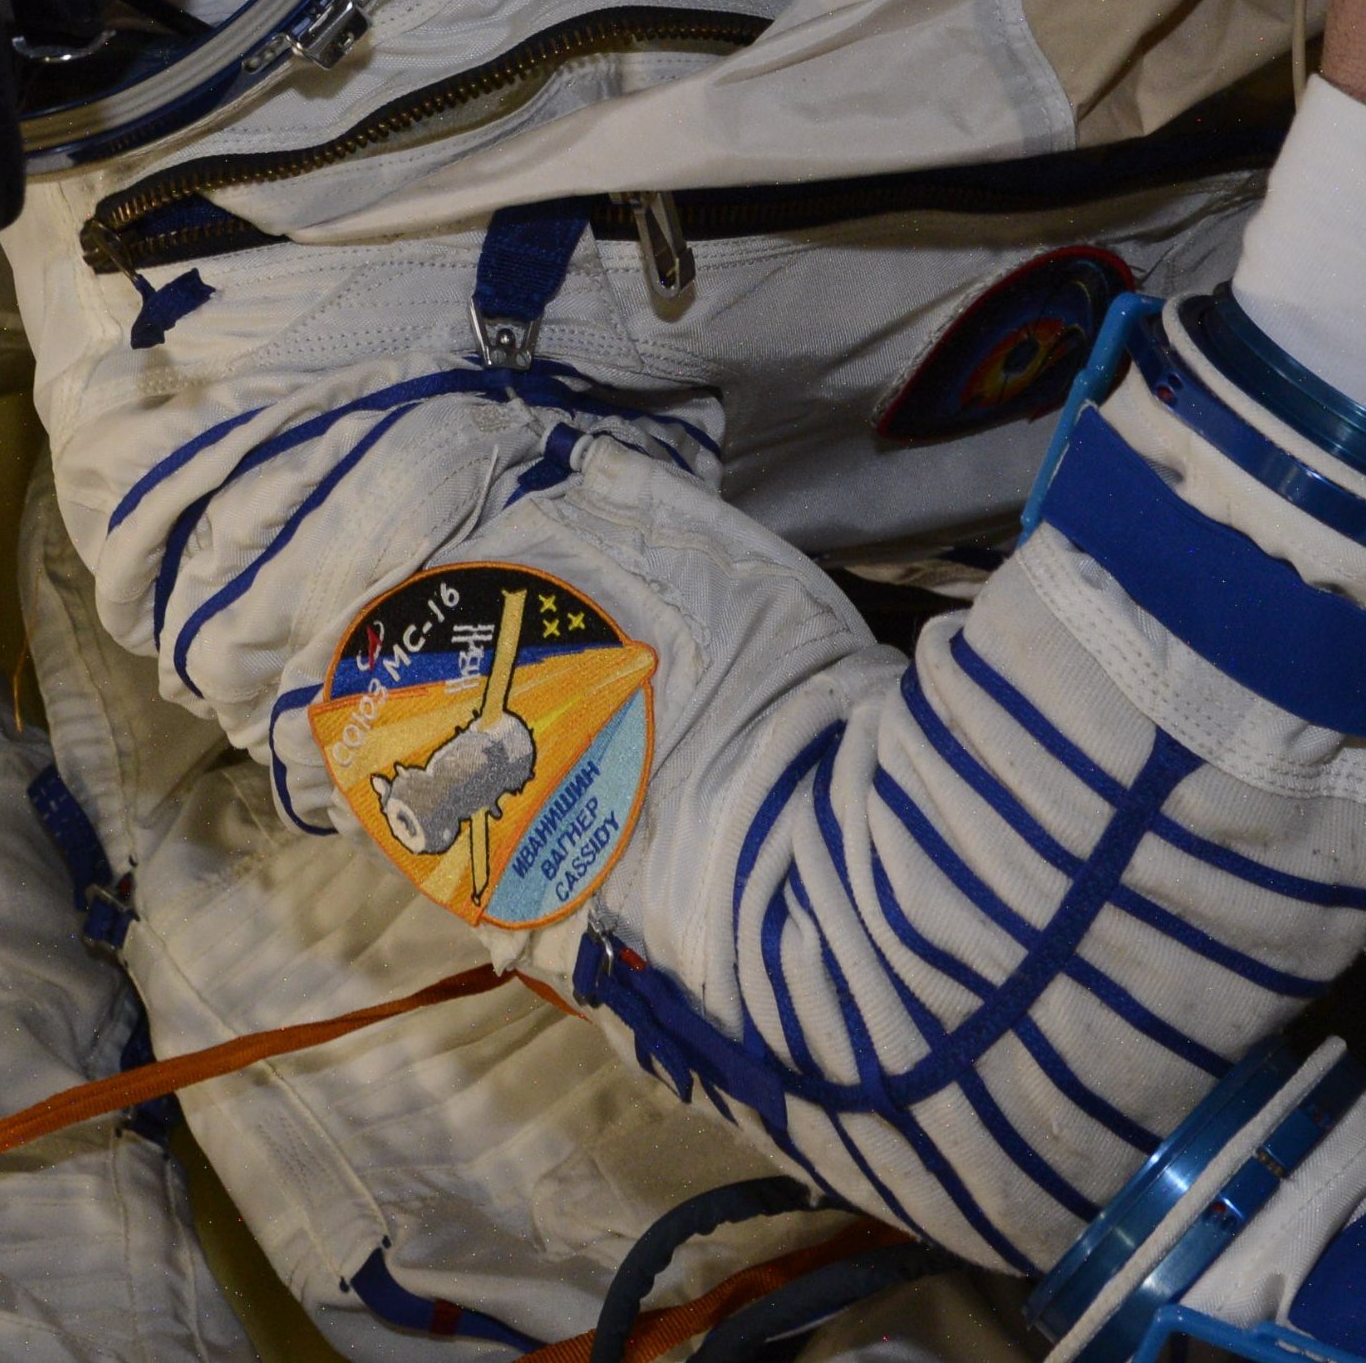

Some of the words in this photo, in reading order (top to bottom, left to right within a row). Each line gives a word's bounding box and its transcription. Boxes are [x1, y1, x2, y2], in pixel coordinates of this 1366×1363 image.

[383, 582, 460, 683] МС-16
[512, 760, 600, 879] ИВАНИШИН
[540, 797, 598, 881] ВАГНЕР
[555, 810, 619, 902] CASSIDY
